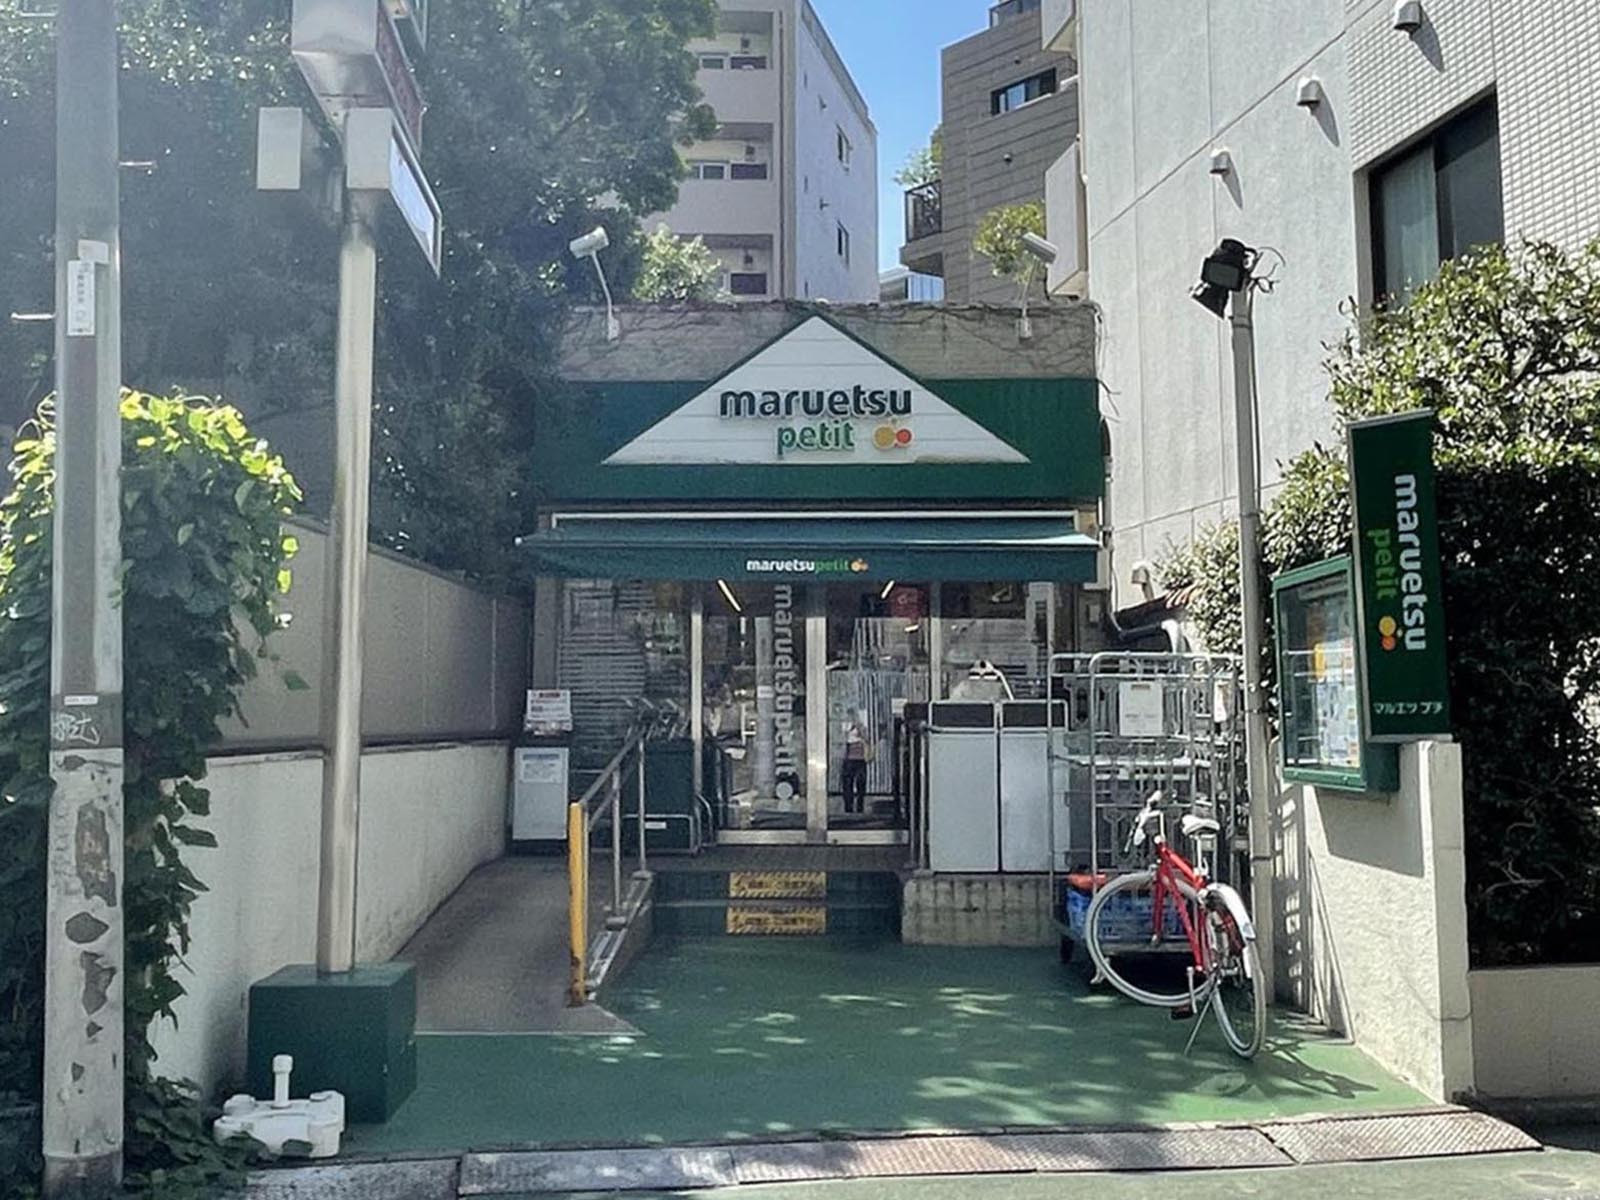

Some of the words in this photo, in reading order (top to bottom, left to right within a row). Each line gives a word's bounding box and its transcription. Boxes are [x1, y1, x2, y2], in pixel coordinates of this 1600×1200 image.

[720, 385, 912, 416] maruetsu
[777, 420, 855, 454] petit
[1367, 528, 1399, 600] petit
[1395, 474, 1428, 650] maruetsu
